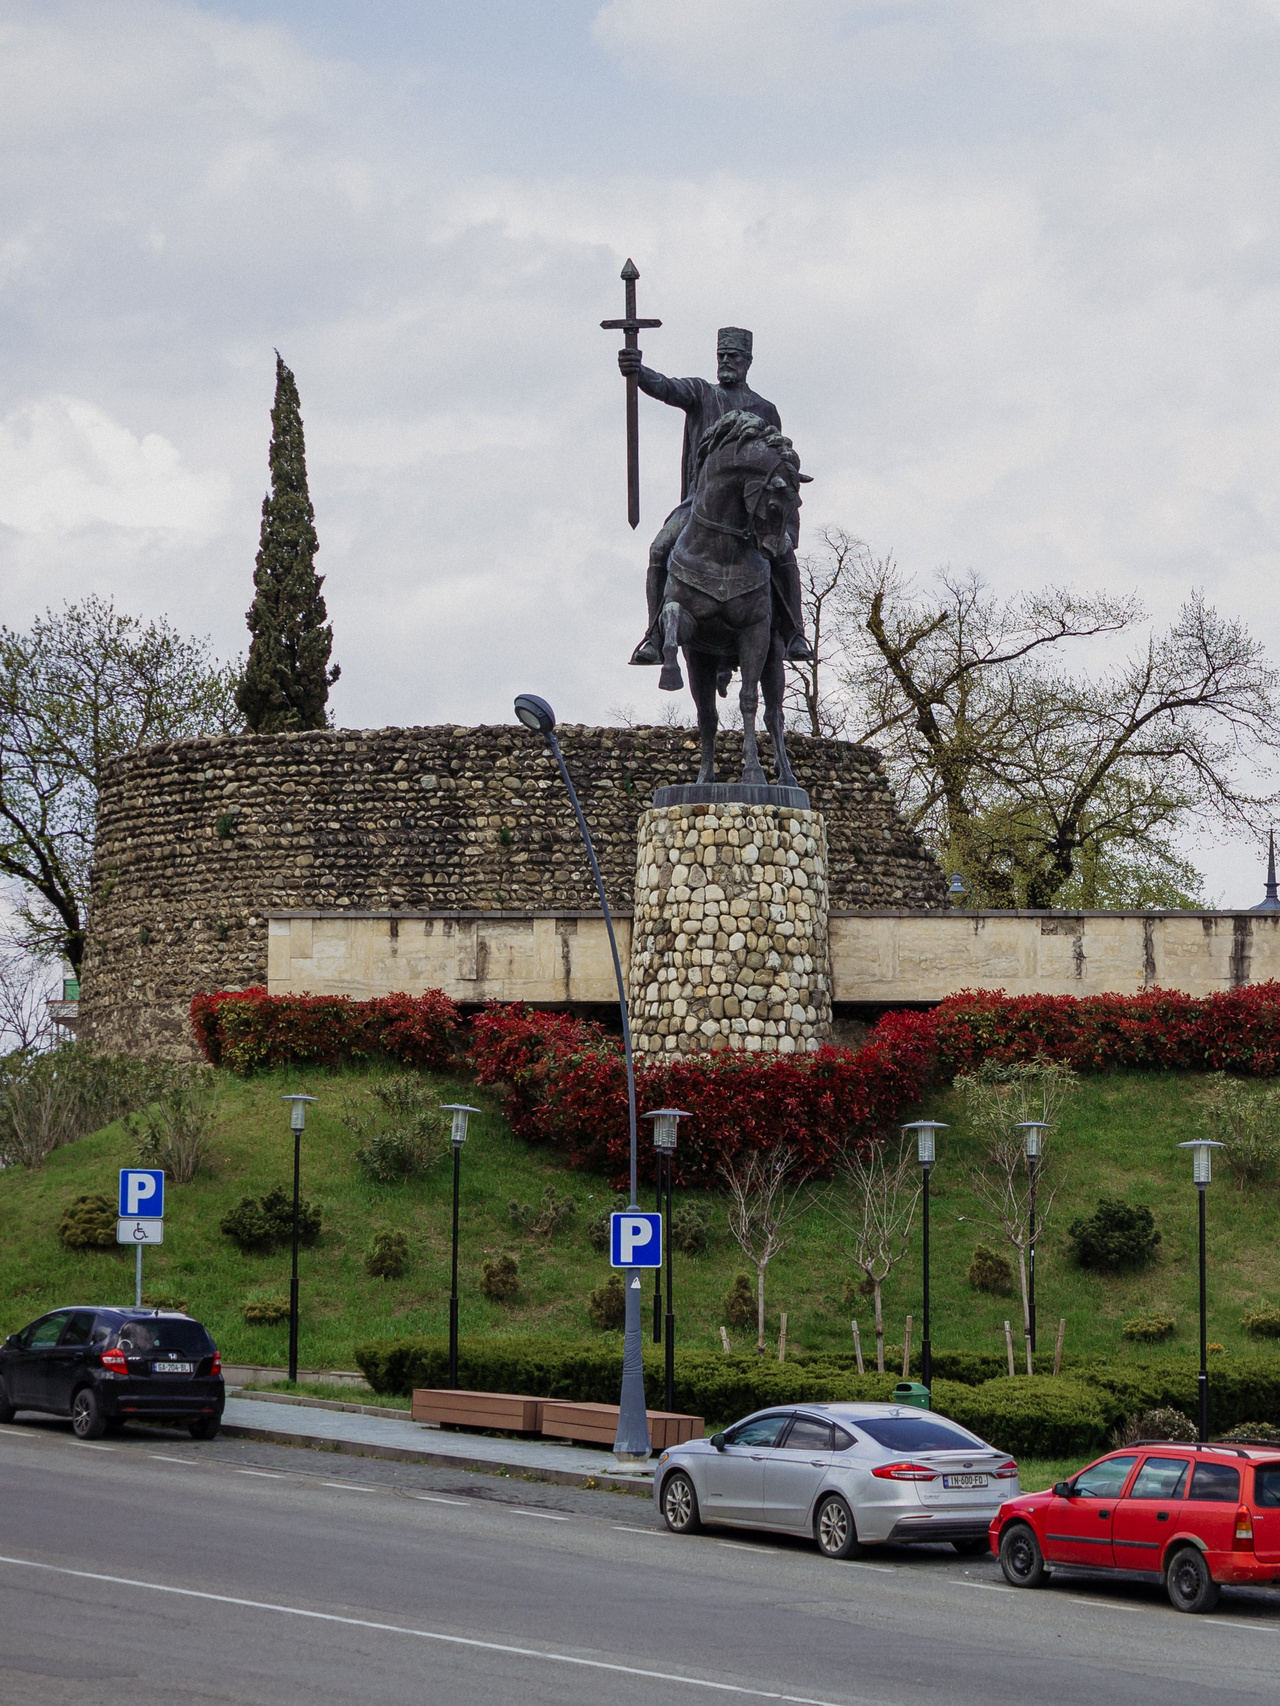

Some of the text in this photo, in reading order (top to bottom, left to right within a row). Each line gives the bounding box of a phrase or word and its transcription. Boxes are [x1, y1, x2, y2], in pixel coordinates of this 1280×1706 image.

[127, 1173, 156, 1214] P
[620, 1217, 653, 1263] P
[950, 1474, 984, 1486] IN-600-FO
